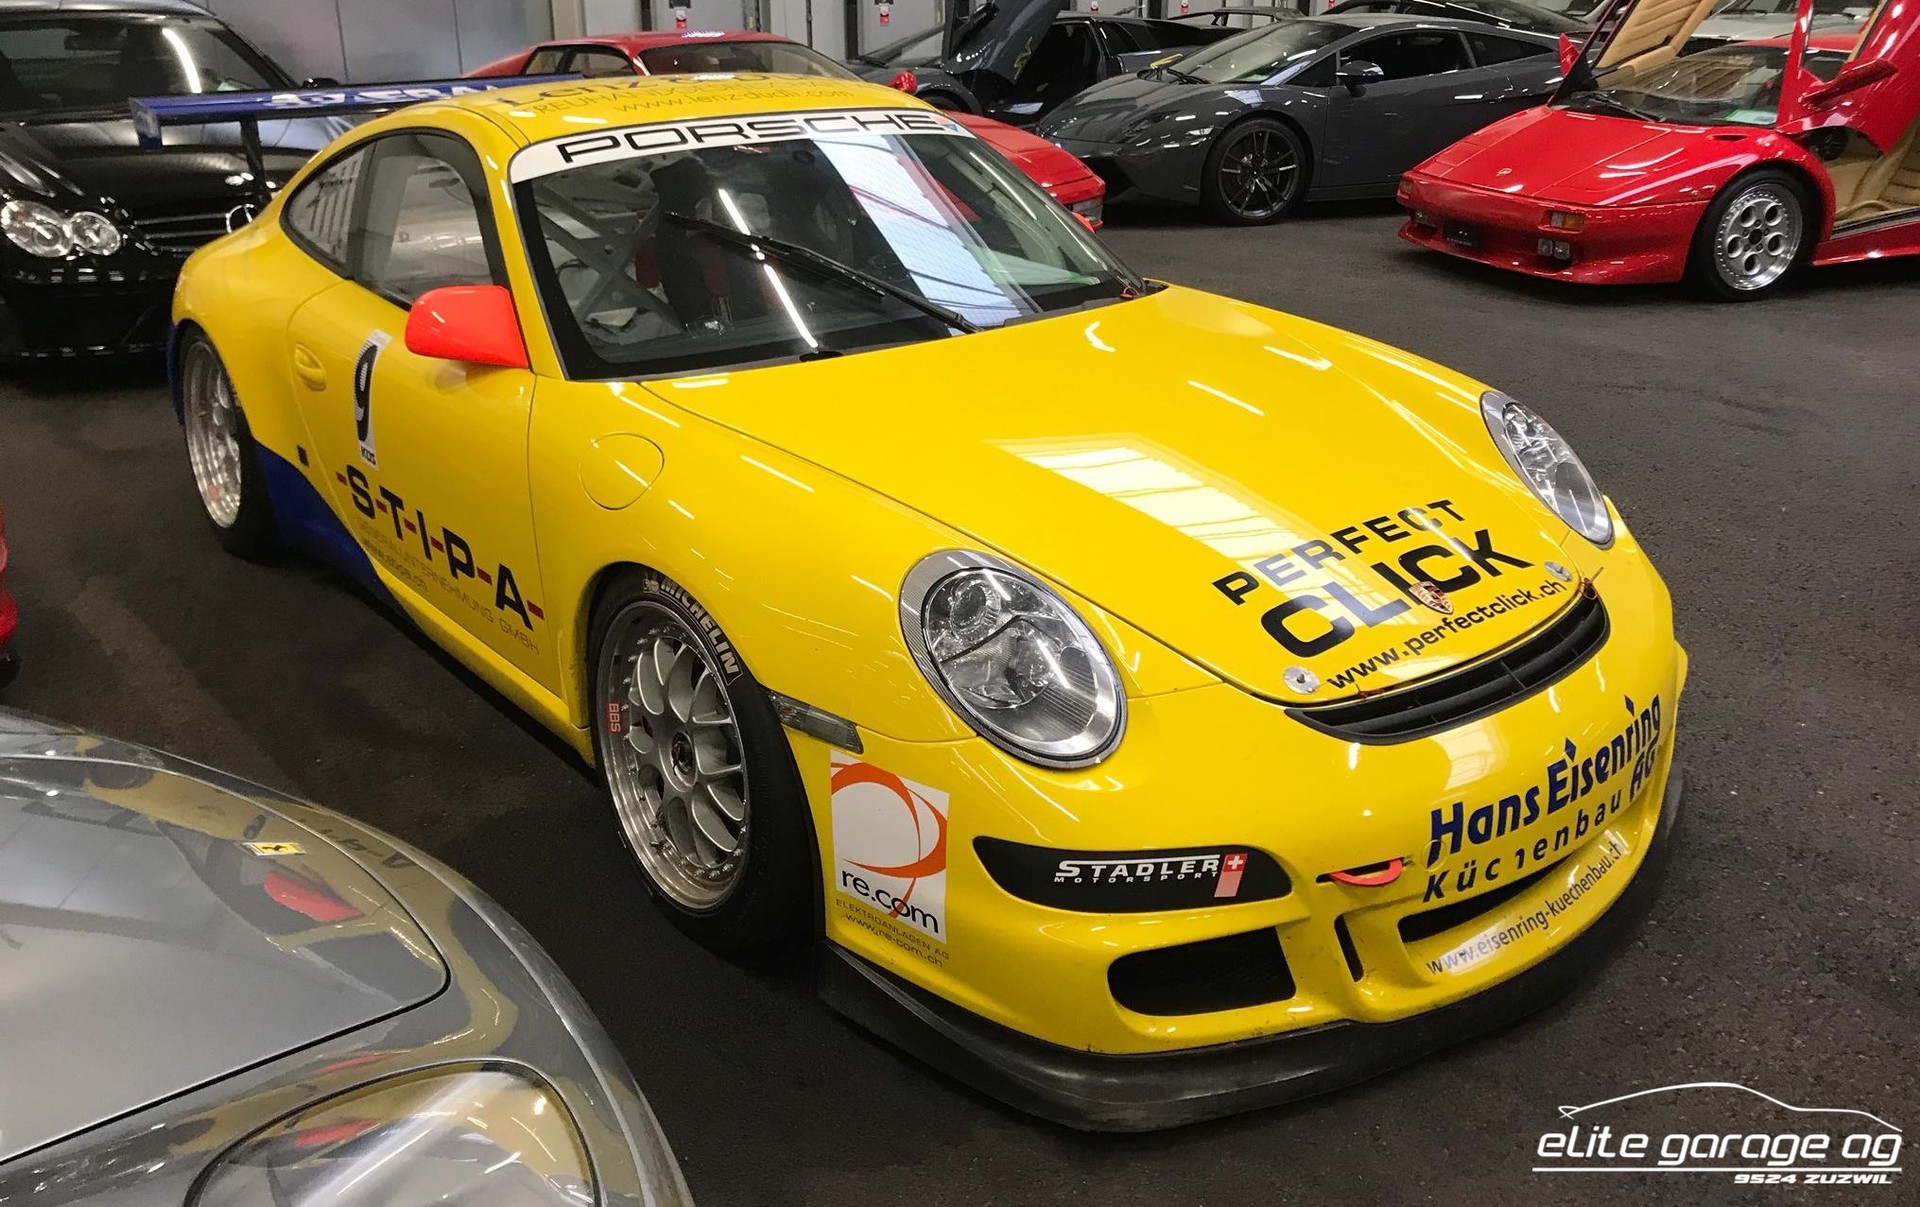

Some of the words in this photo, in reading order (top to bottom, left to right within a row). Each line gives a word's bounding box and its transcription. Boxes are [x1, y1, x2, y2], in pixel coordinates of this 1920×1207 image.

[556, 113, 946, 163] PORSCHE
[355, 344, 378, 442] 9
[1212, 500, 1466, 606] PERFECT
[1261, 528, 1535, 658] CLICK
[661, 578, 739, 674] MICHELIN
[1327, 579, 1567, 690] www.perfectclick.ch
[609, 702, 621, 733] BBS
[1427, 784, 1540, 868] Hans
[1547, 694, 1661, 815] Eisenring
[842, 870, 939, 934] re.com
[1054, 871, 1219, 884] MOTORSPORT
[1056, 854, 1220, 877] STADLER
[836, 899, 931, 950] ELEKTROANLAGEN
[934, 947, 949, 961] AG
